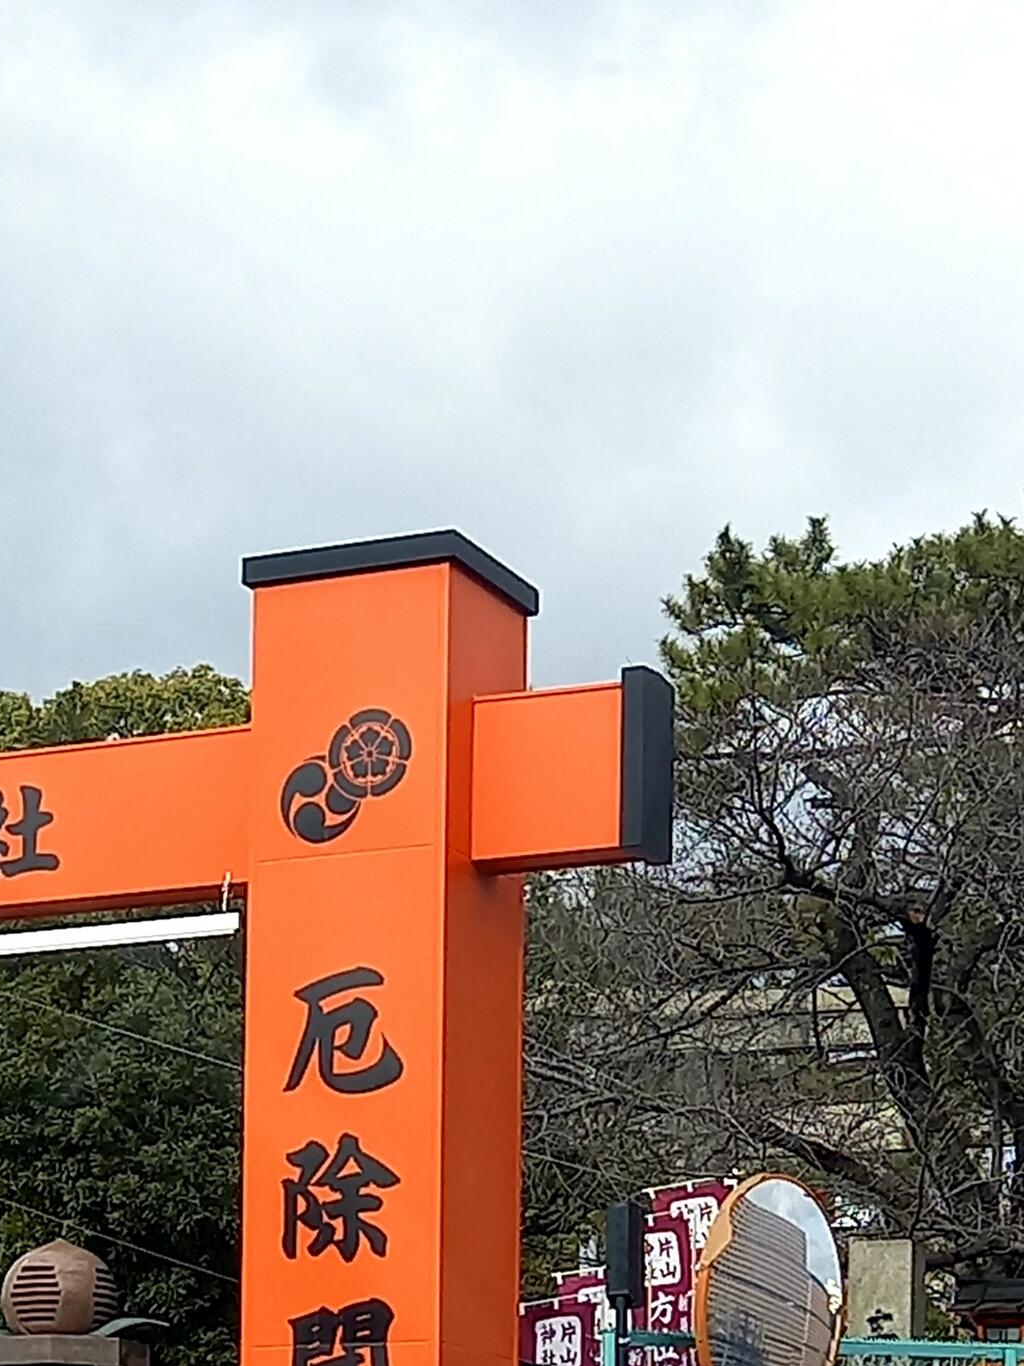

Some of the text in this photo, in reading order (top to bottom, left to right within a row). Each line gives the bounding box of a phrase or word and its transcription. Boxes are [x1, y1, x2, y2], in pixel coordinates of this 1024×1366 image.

[657, 1236, 678, 1280] 片山
[540, 1321, 558, 1366] 神社
[560, 1320, 578, 1366] 片山
